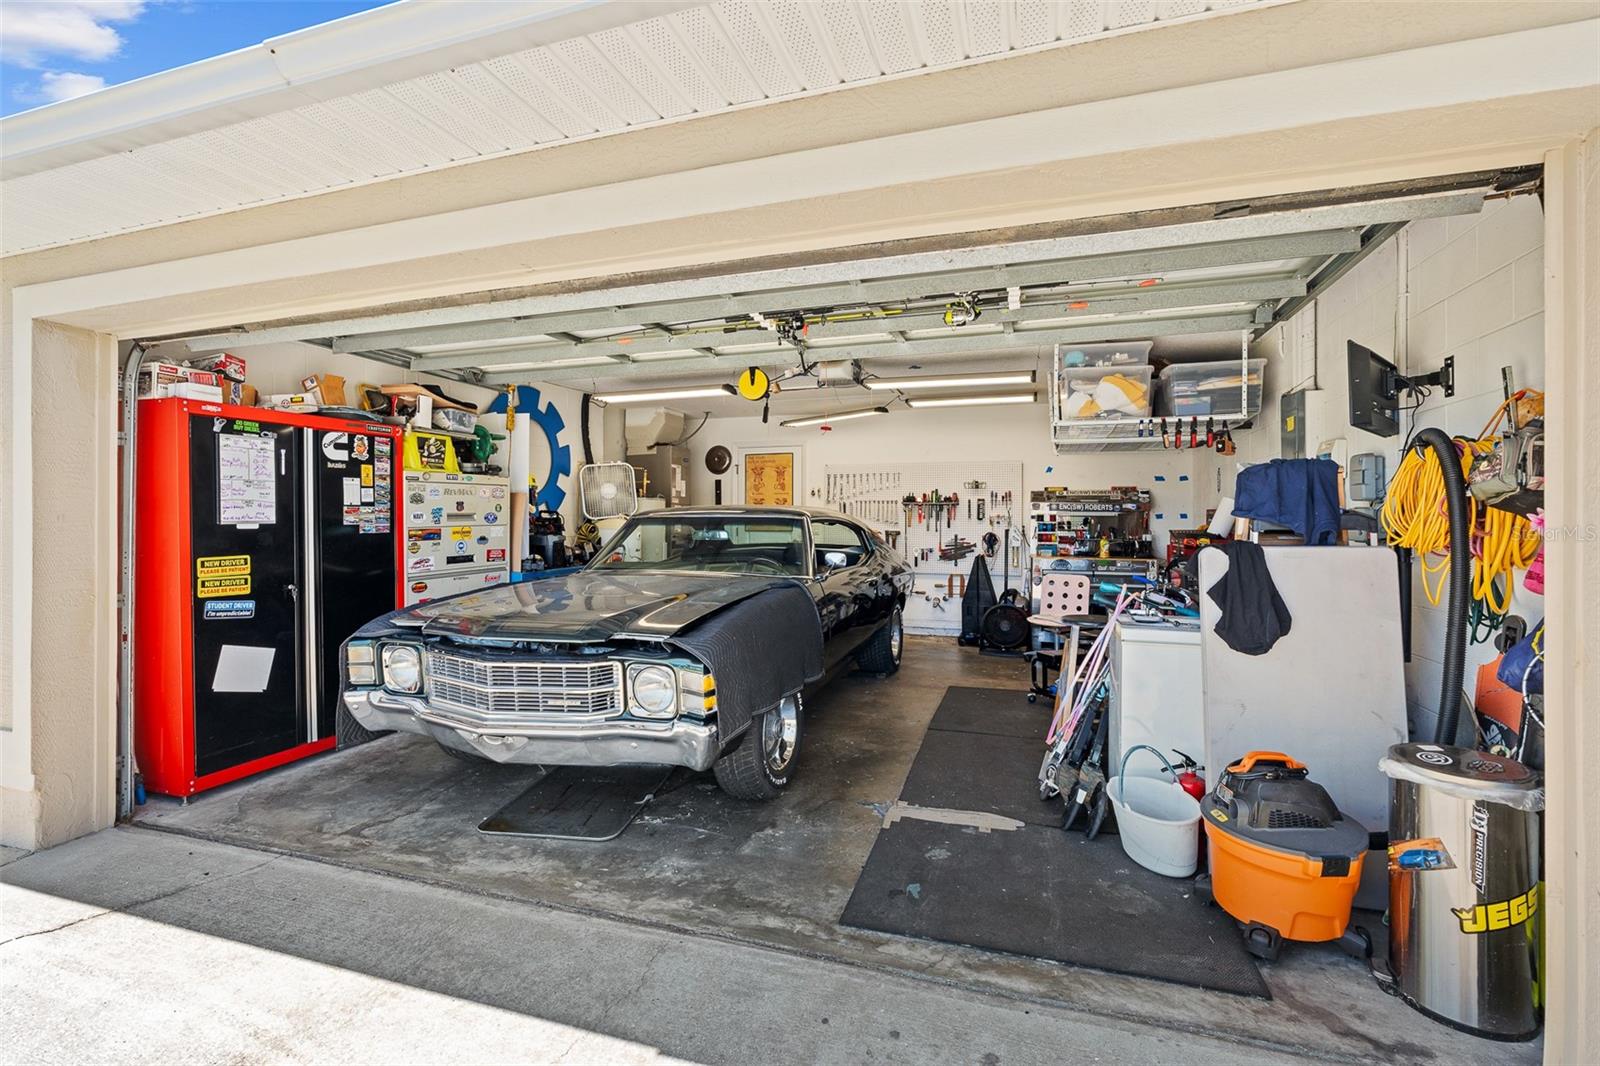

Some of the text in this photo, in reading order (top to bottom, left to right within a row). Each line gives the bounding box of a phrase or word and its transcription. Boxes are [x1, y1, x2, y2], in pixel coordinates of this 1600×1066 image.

[323, 432, 346, 448] Cummins
[1084, 503, 1114, 511] ROBERTS
[1475, 832, 1484, 885] PRECISION
[1461, 884, 1537, 933] JEGS
